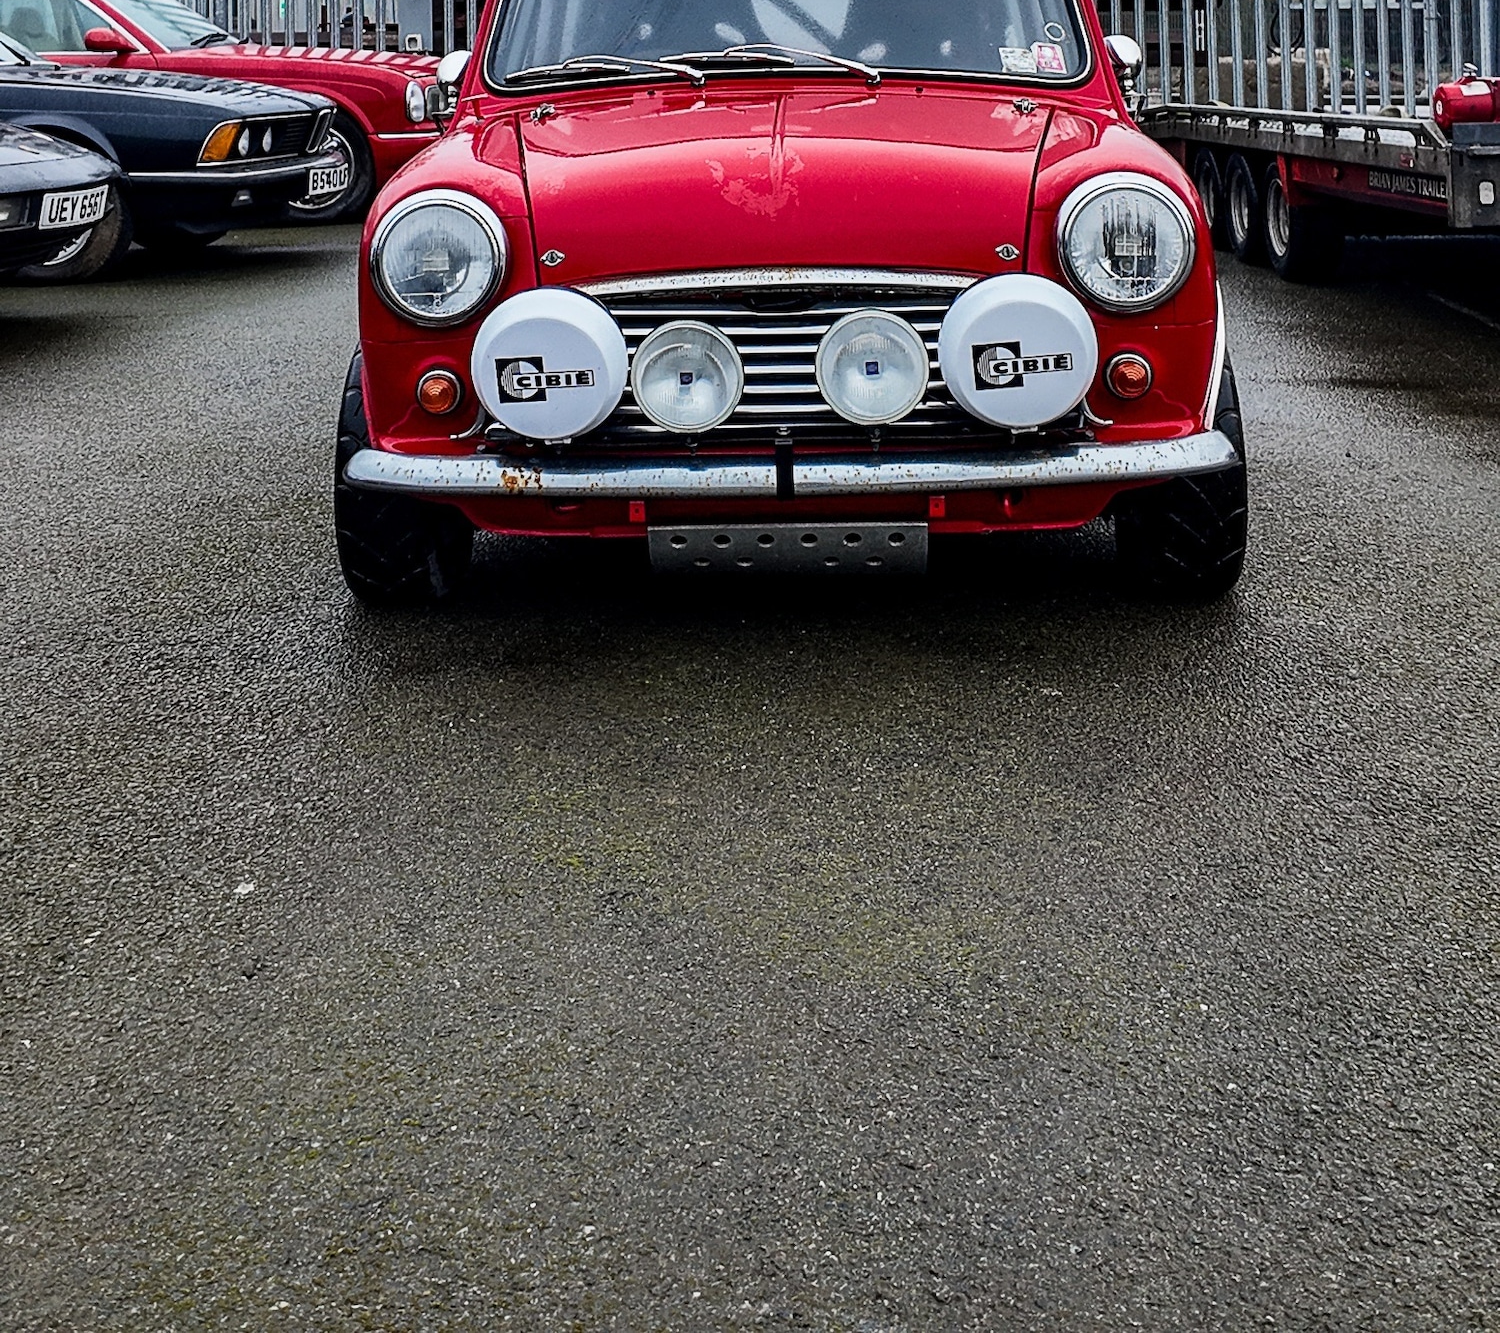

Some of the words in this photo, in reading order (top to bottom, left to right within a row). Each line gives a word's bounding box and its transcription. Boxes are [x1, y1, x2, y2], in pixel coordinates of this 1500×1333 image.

[1368, 171, 1391, 188] BRIAN
[1391, 174, 1416, 193] JAMES
[1418, 178, 1448, 199] TRAILE
[48, 196, 79, 223] UEY
